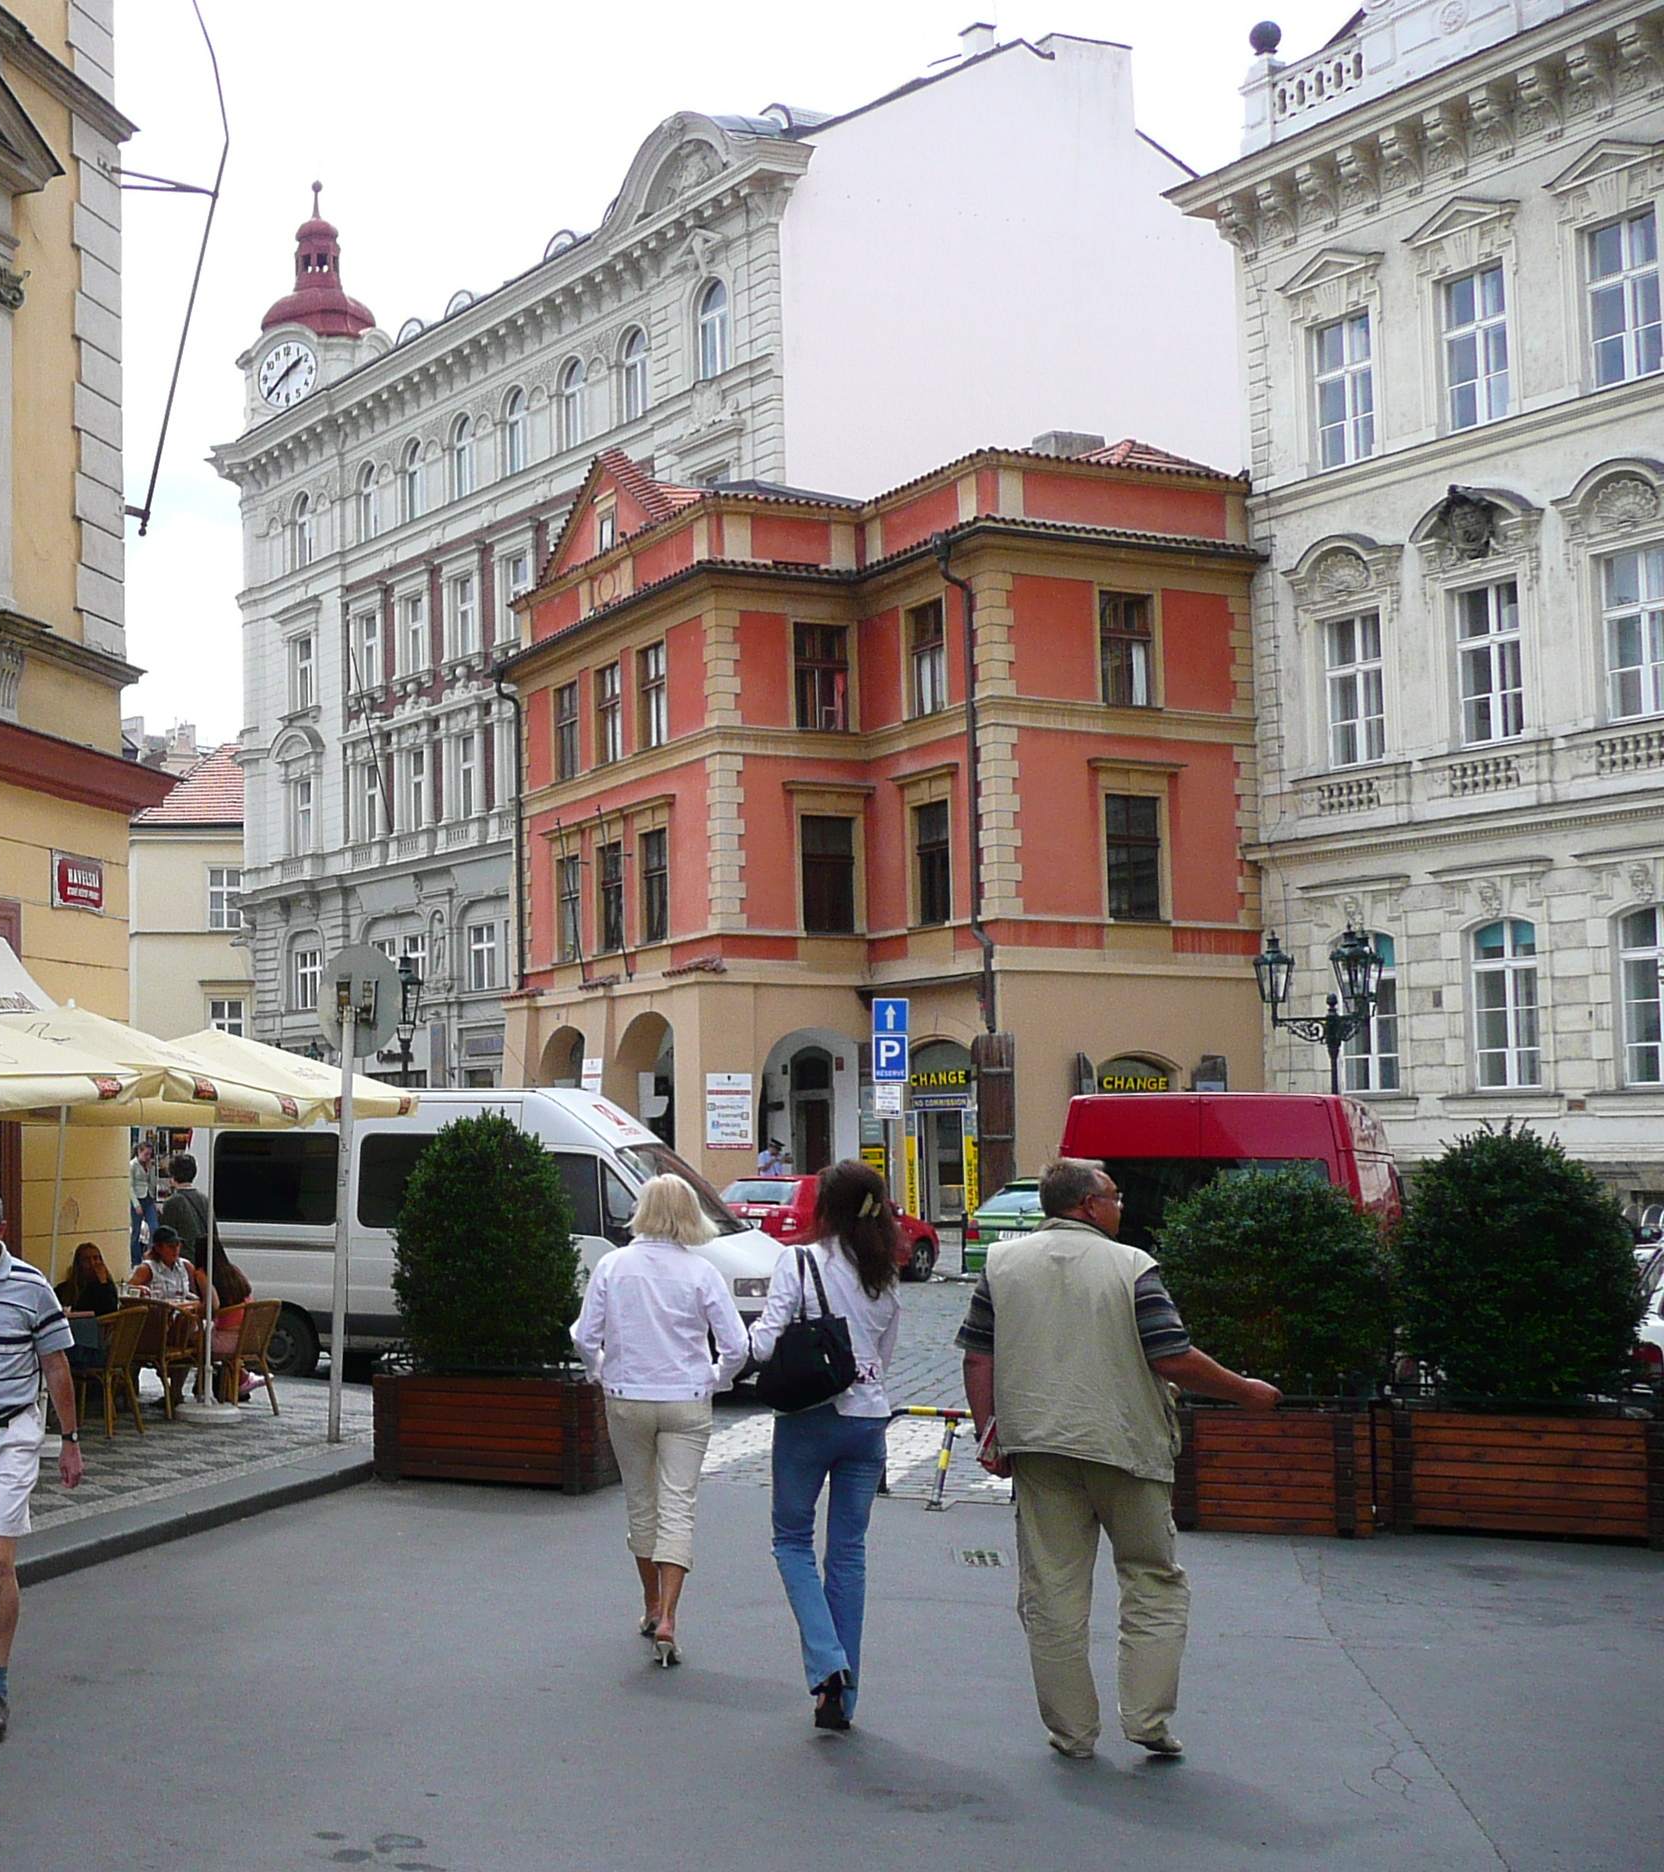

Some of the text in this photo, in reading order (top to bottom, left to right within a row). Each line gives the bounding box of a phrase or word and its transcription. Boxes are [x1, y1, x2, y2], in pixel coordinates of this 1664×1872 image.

[880, 1040, 900, 1067] P
[910, 1070, 966, 1087] CHANGE
[1103, 1076, 1168, 1090] CHANGE
[914, 1099, 923, 1107] NO
